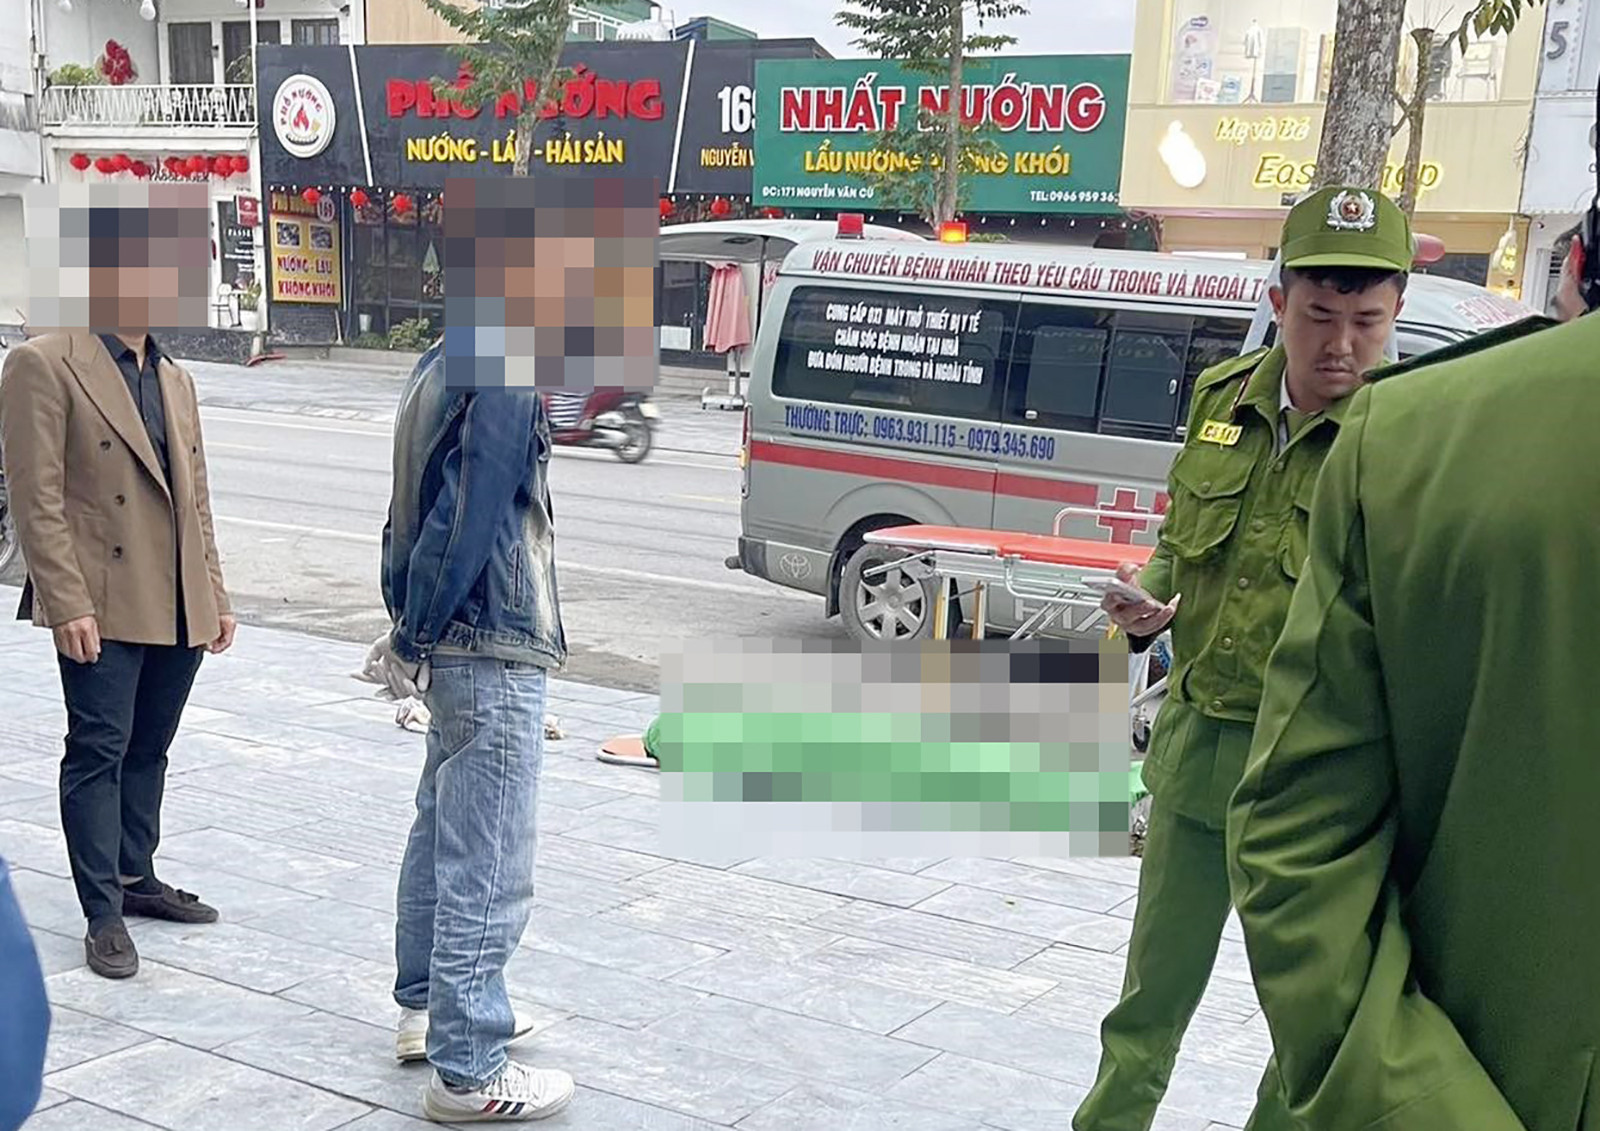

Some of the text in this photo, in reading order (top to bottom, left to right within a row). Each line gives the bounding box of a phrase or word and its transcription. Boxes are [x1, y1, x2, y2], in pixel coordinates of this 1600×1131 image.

[779, 72, 1106, 133] NHẤT NƯỚNG
[406, 130, 477, 162] NƯỚNG
[492, 129, 516, 163] LẨ
[545, 131, 581, 163] HẢI
[583, 130, 624, 163] SẢN
[700, 141, 747, 168] NGUYỄN
[804, 139, 843, 172] LẨU
[1013, 144, 1070, 174] KHÓI
[992, 262, 1032, 286] THEO
[1107, 269, 1162, 296] TRONG
[872, 415, 957, 448] 0963.931.115
[967, 427, 1056, 461] 0979.345.690
